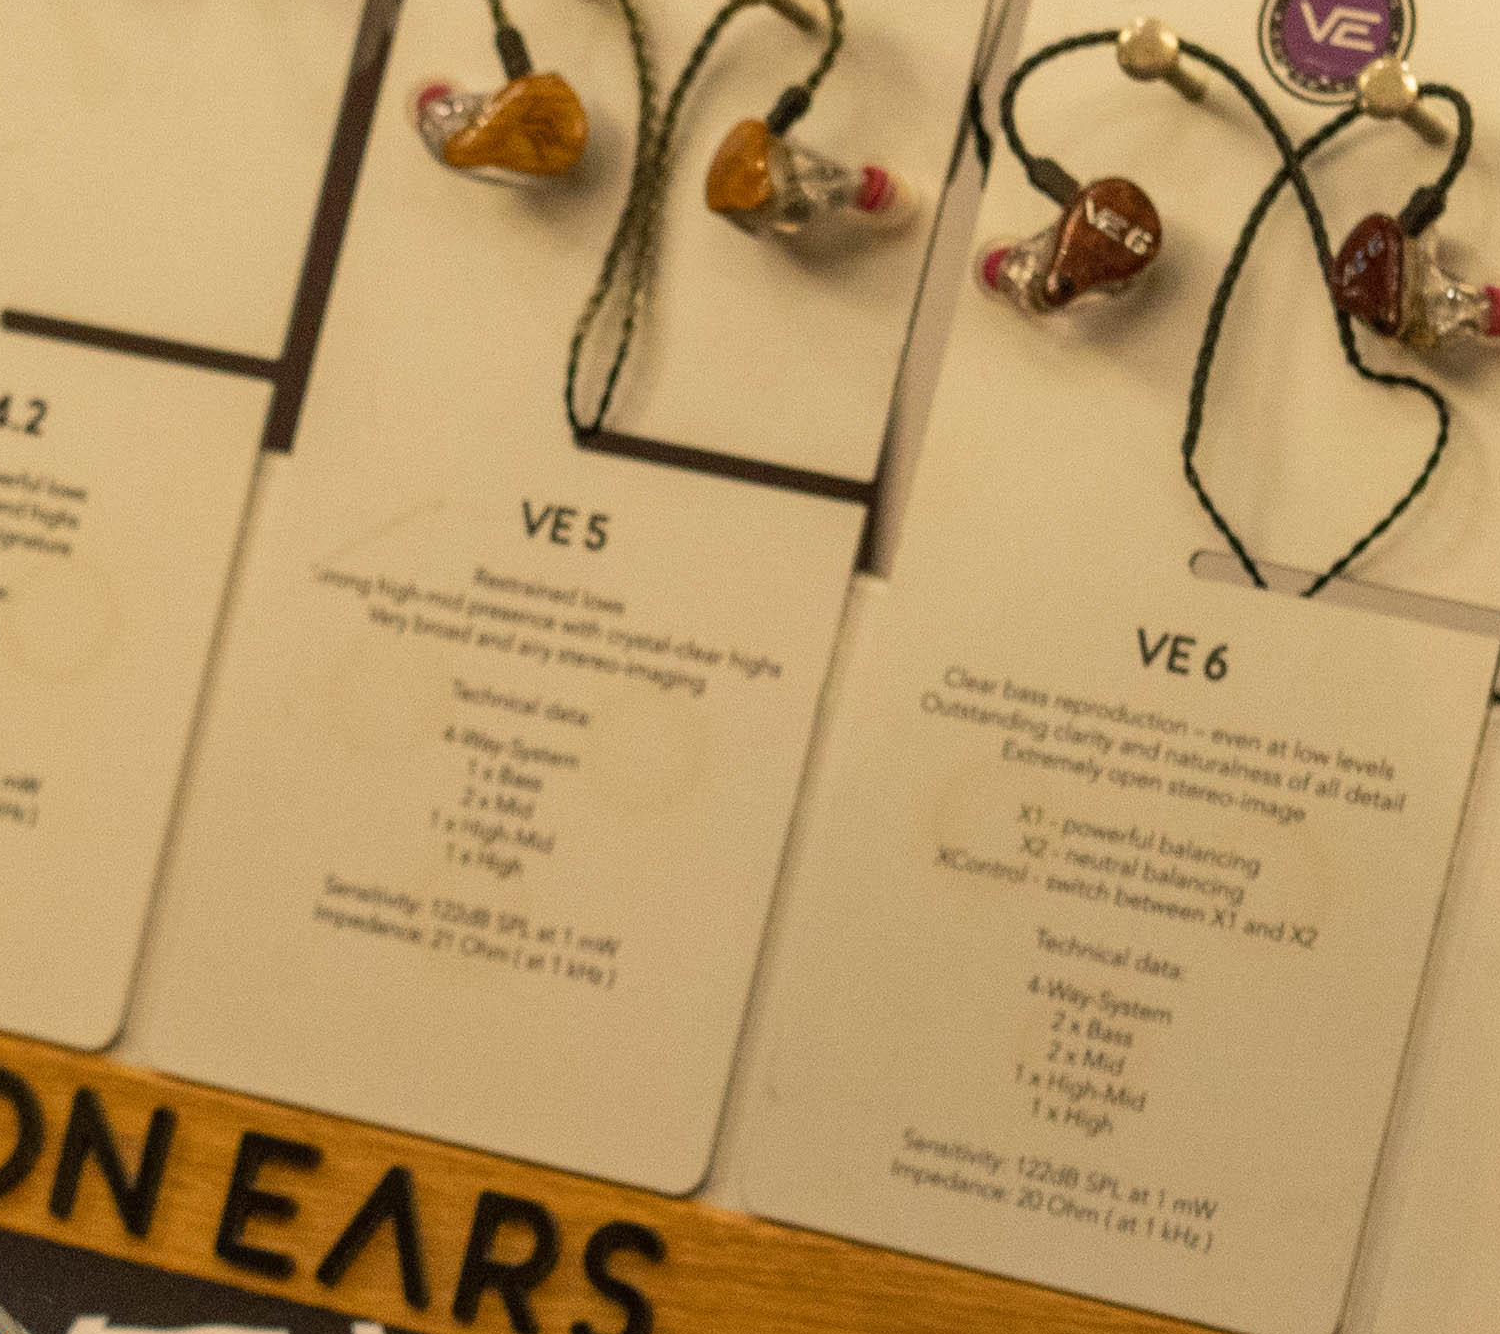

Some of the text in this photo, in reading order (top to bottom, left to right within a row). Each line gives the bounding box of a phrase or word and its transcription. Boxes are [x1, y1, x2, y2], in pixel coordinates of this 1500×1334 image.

[522, 501, 609, 552] VE 5
[1137, 628, 1228, 682] VE 6
